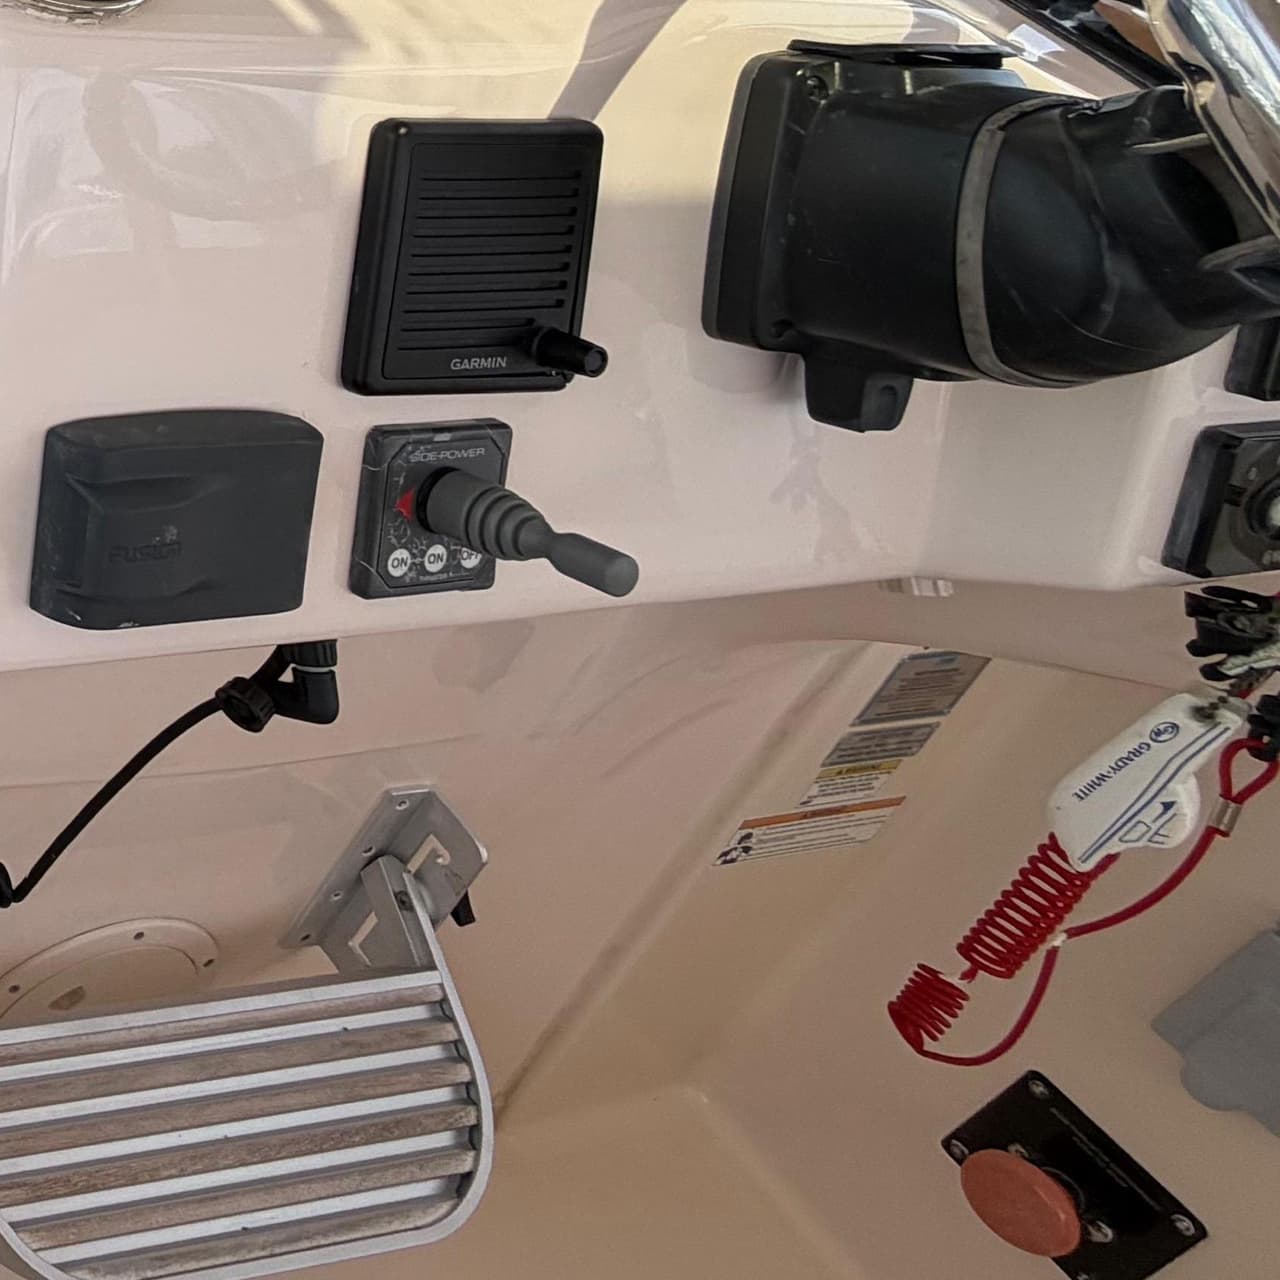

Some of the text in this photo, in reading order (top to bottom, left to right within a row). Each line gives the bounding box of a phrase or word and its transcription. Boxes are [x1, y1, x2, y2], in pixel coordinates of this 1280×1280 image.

[450, 356, 508, 371] GARMIN
[391, 556, 409, 569] ON
[427, 552, 444, 565] ON
